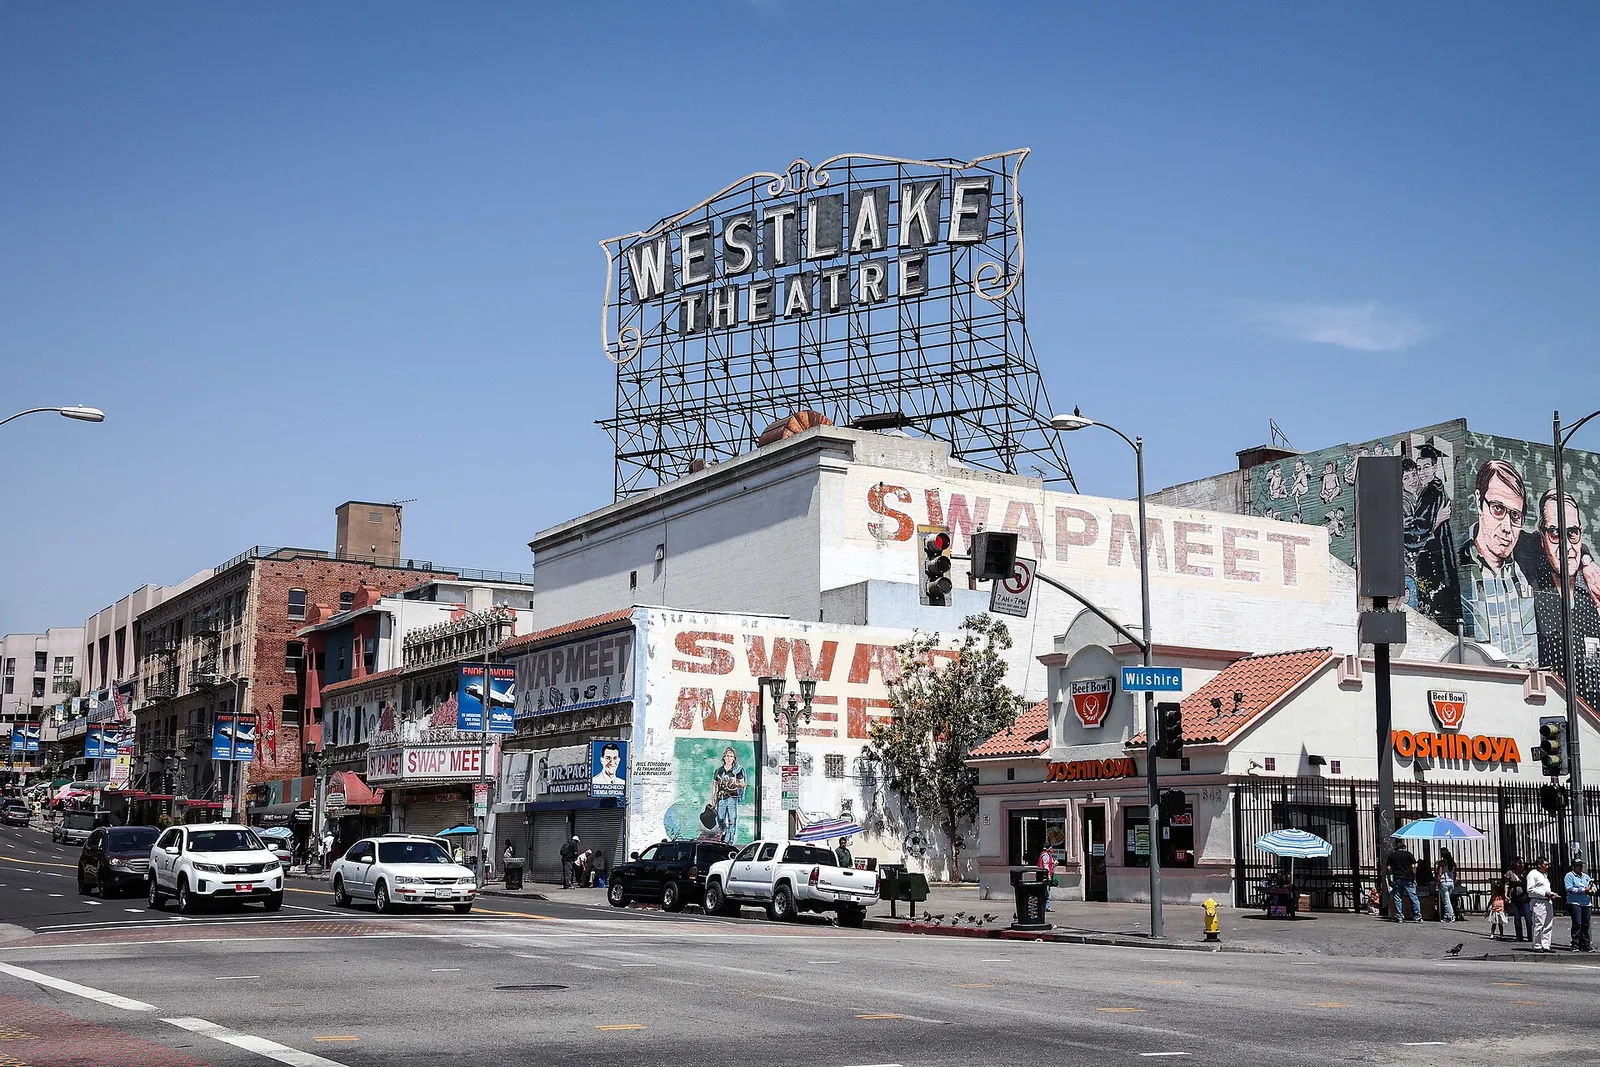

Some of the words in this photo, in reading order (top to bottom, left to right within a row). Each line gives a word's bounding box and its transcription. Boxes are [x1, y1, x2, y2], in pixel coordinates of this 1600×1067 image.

[627, 177, 991, 301] WESTLAKE
[680, 252, 925, 333] THEATRE
[515, 635, 630, 693] WAPMEET
[1072, 682, 1090, 693] Beef
[1091, 680, 1111, 692] Bowl
[1125, 673, 1179, 685] Wilshire
[331, 695, 358, 710] SWAP
[364, 685, 396, 703] MEET
[1432, 691, 1448, 700] Beef
[1448, 693, 1465, 702] Bowl
[669, 687, 948, 742] MEE
[408, 752, 446, 773] SWAP
[1046, 757, 1136, 780] YOSHINOYA
